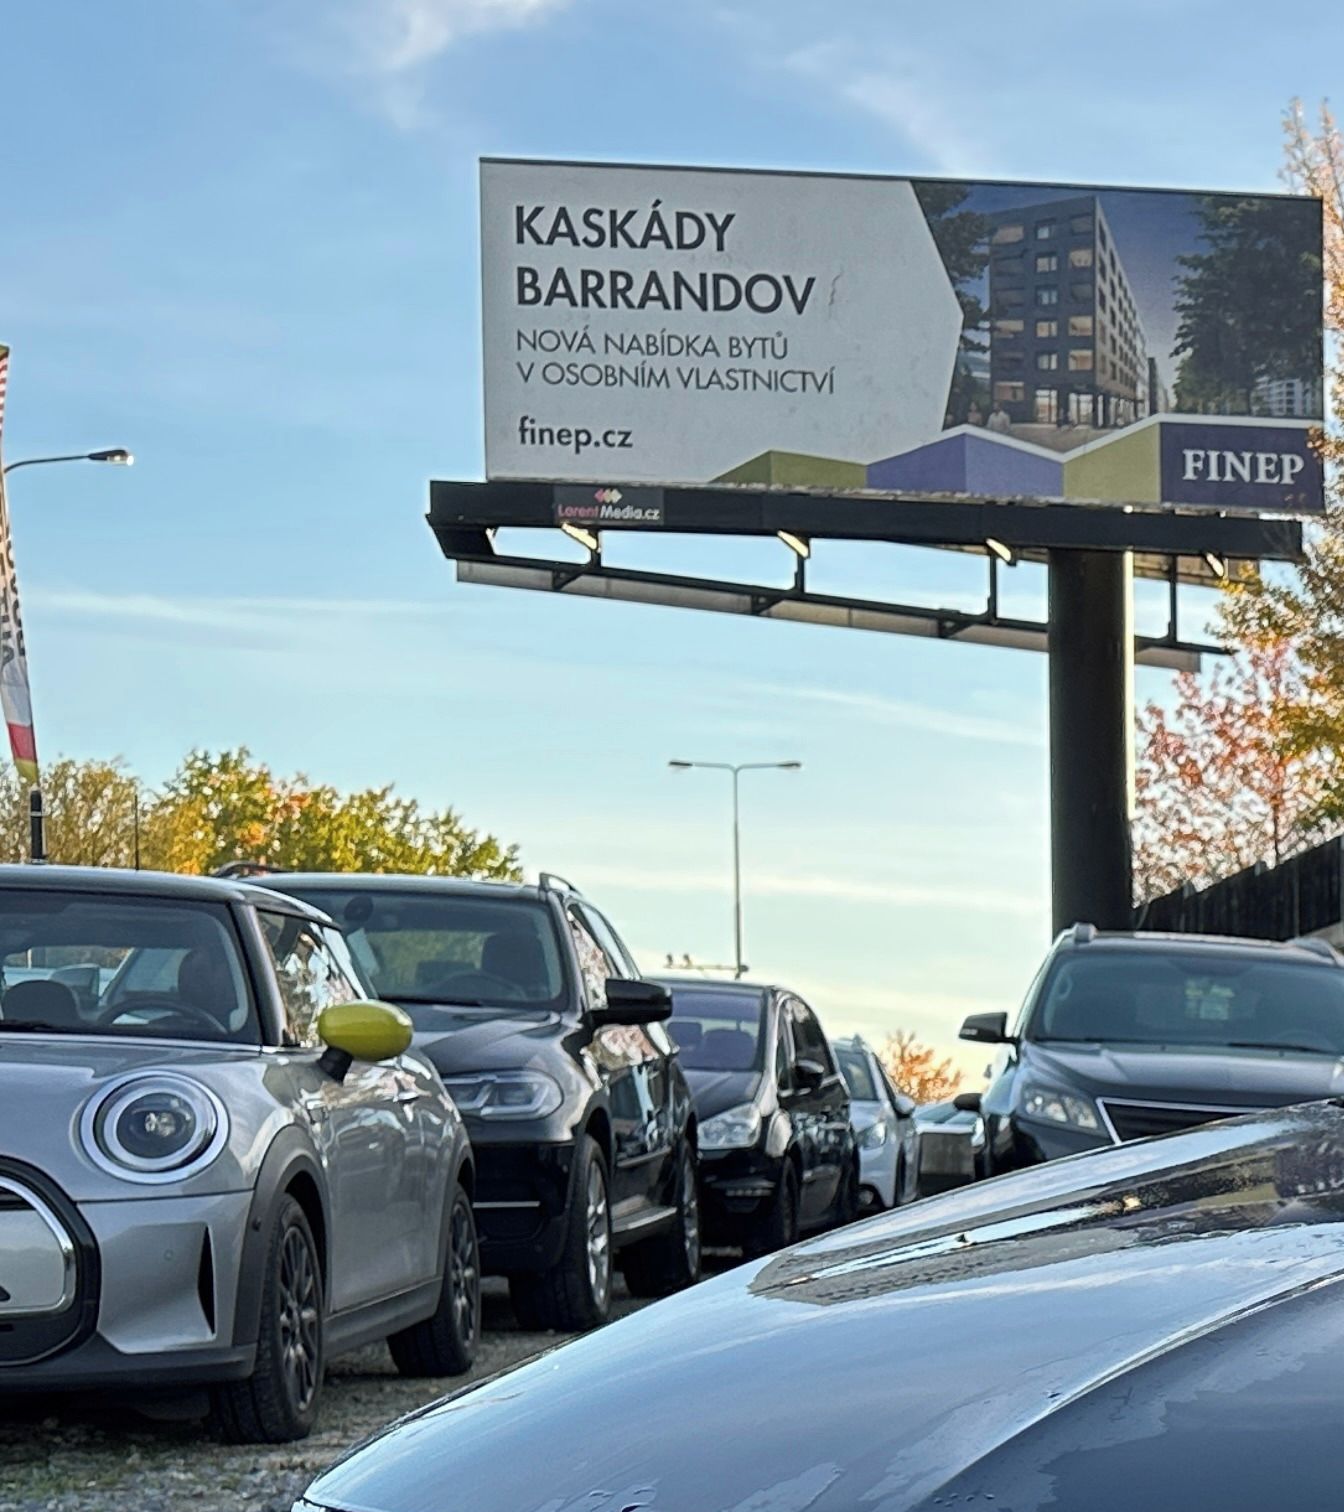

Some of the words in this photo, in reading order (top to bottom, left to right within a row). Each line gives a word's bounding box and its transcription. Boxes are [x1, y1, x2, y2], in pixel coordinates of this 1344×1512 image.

[515, 199, 735, 251] KASKÁDY
[516, 266, 816, 315] BARRANDOV
[517, 326, 596, 354] NOVÁ
[604, 328, 720, 357] NABÍDKA
[728, 331, 788, 359] BYTŮ
[517, 361, 535, 383] V
[542, 360, 670, 388] OSOBNÍM
[676, 366, 835, 394] VLASTNICTVÍ
[519, 415, 633, 454] finep.cz
[1182, 449, 1304, 485] FINEP
